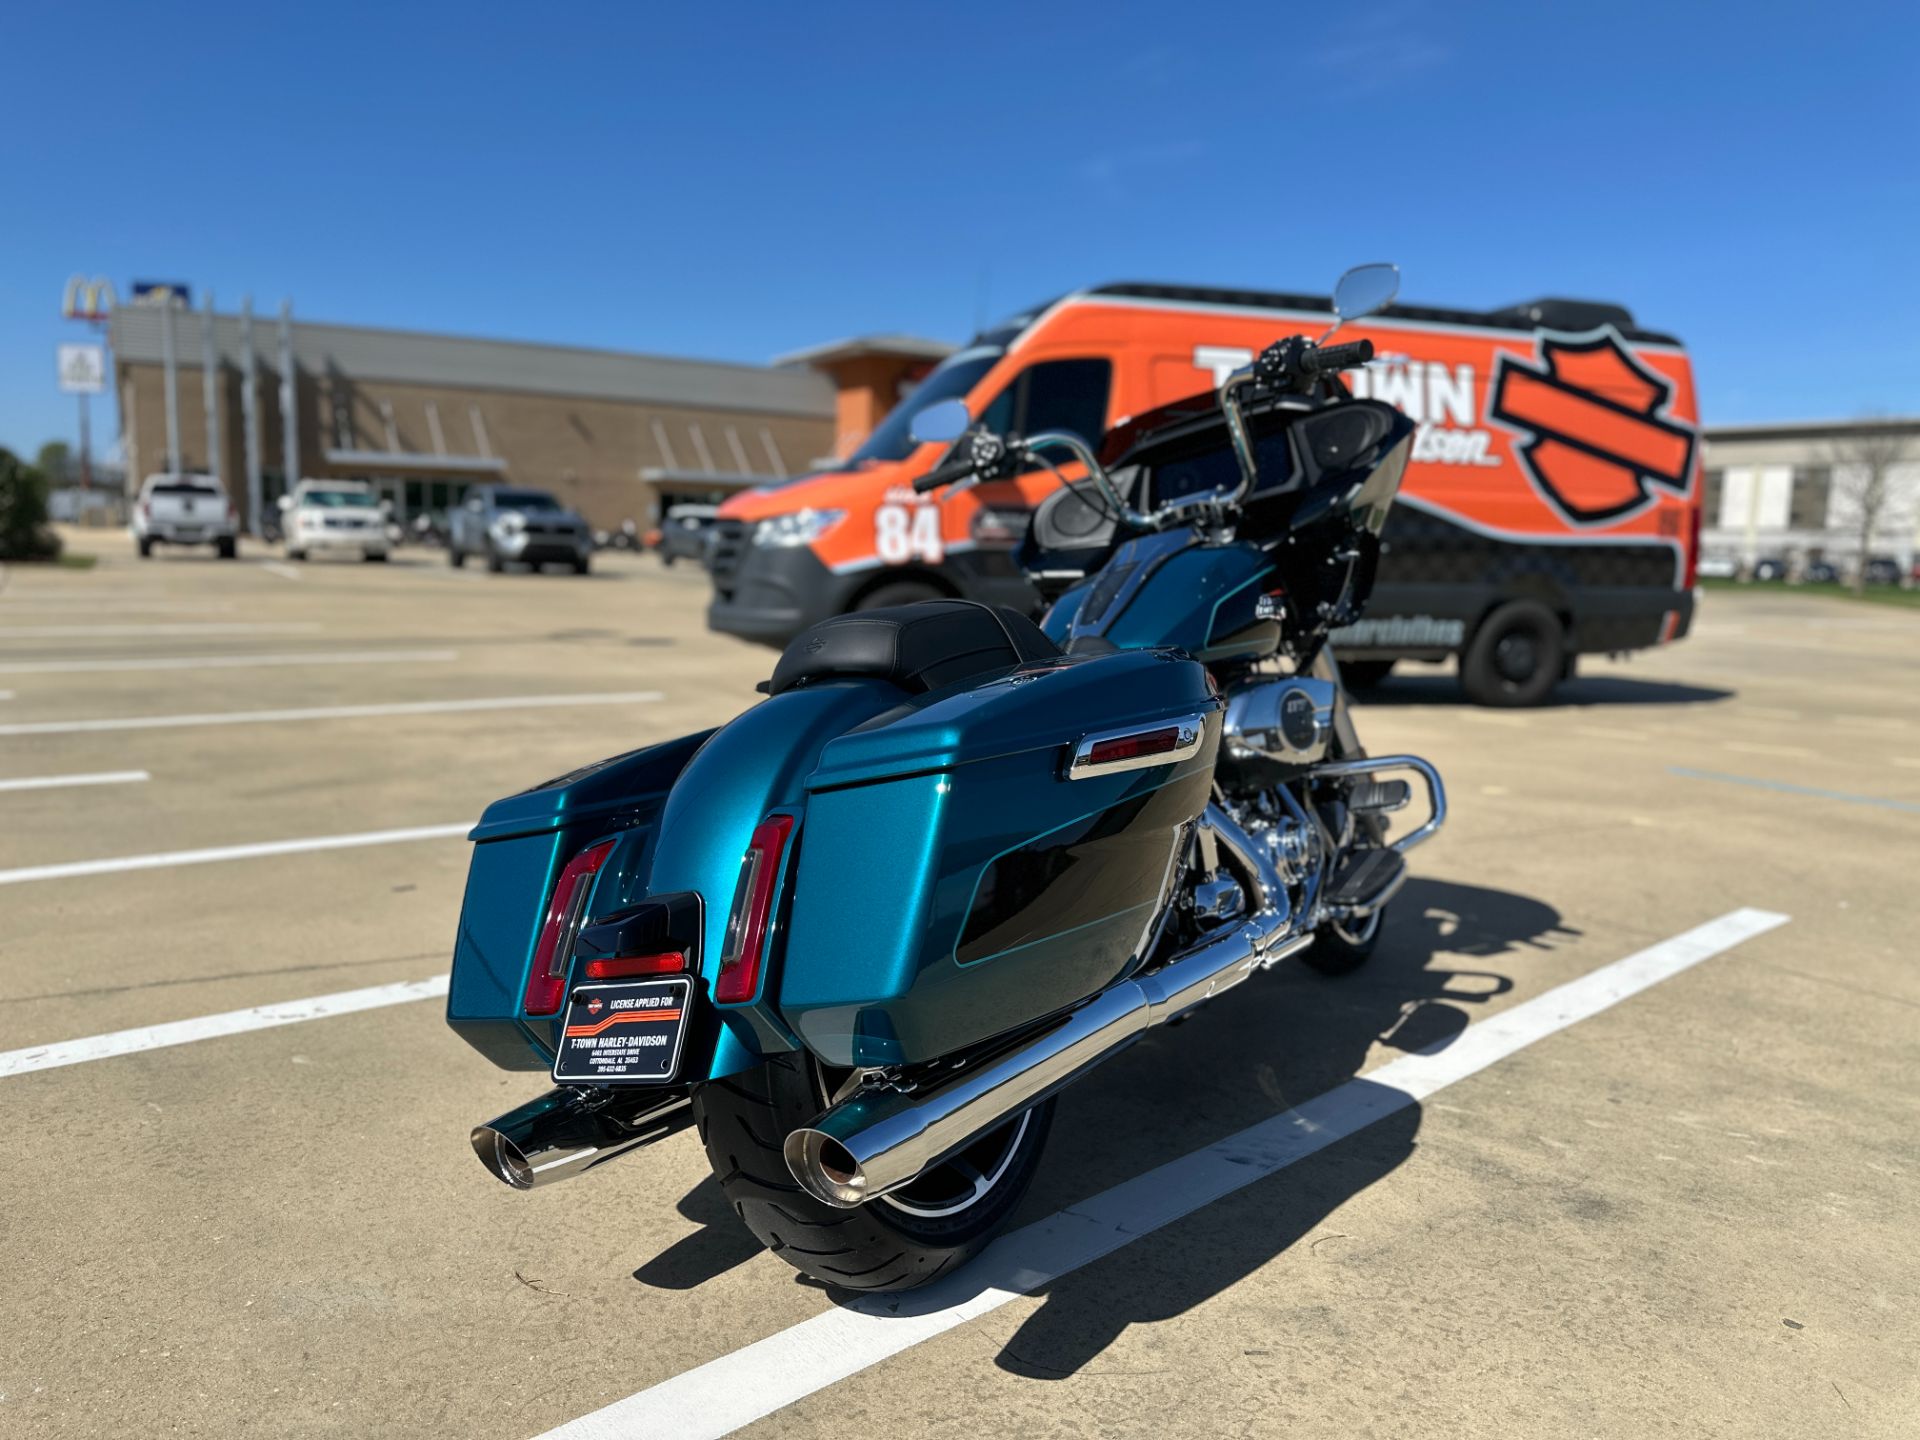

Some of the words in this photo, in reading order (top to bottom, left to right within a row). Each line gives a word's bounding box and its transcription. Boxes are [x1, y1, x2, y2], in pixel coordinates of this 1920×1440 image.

[874, 504, 943, 563] 84
[610, 998, 634, 1009] LICENSE
[634, 997, 660, 1008] APPLIED
[660, 996, 673, 1006] FOR
[571, 1037, 597, 1049] T-TOWN
[598, 1036, 667, 1048] HARLEY-DAVIDSON
